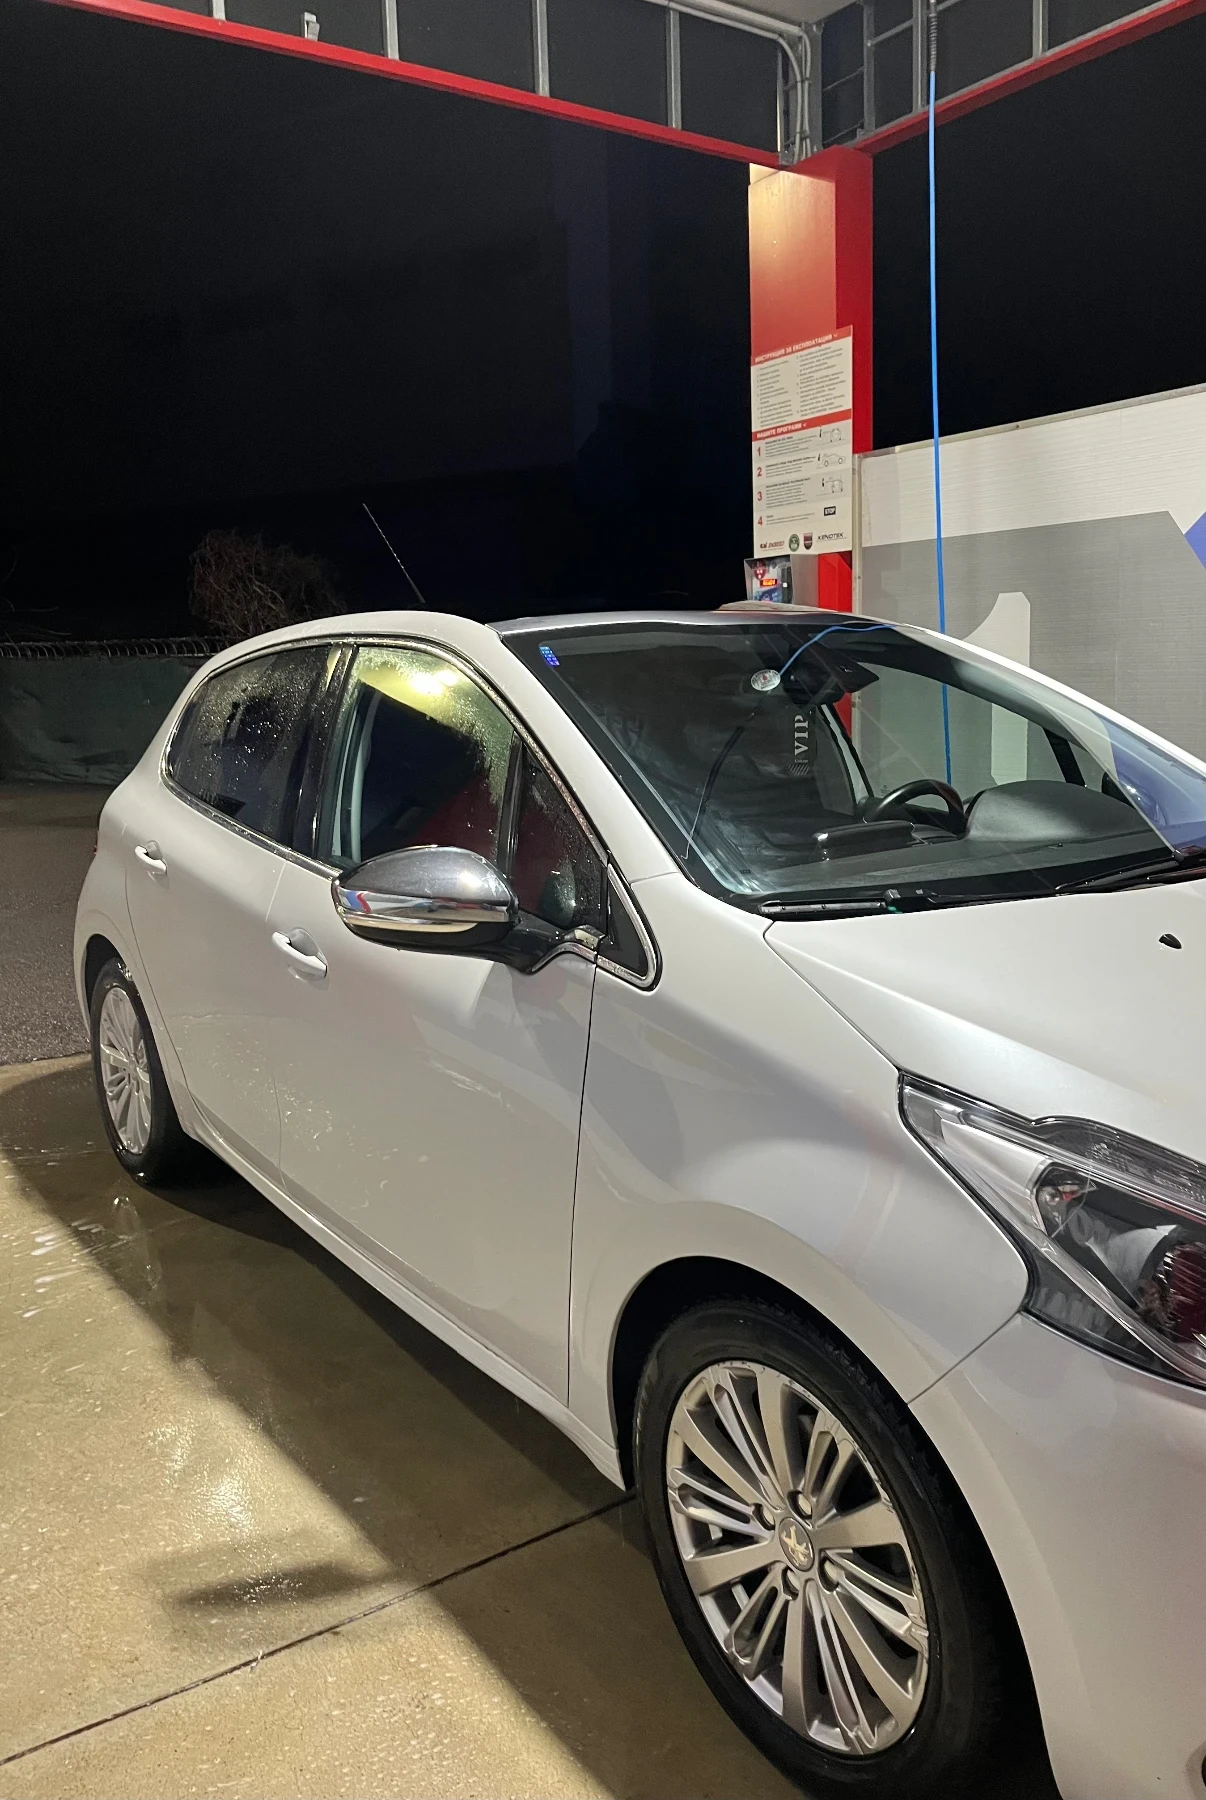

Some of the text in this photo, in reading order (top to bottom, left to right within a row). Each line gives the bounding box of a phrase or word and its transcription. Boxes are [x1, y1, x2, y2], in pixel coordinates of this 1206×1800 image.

[757, 447, 761, 457] 1
[757, 467, 762, 477] 2
[757, 491, 762, 501] 3
[758, 516, 763, 526] 4
[818, 532, 843, 541] KENOTEK
[795, 715, 808, 756] VIP
